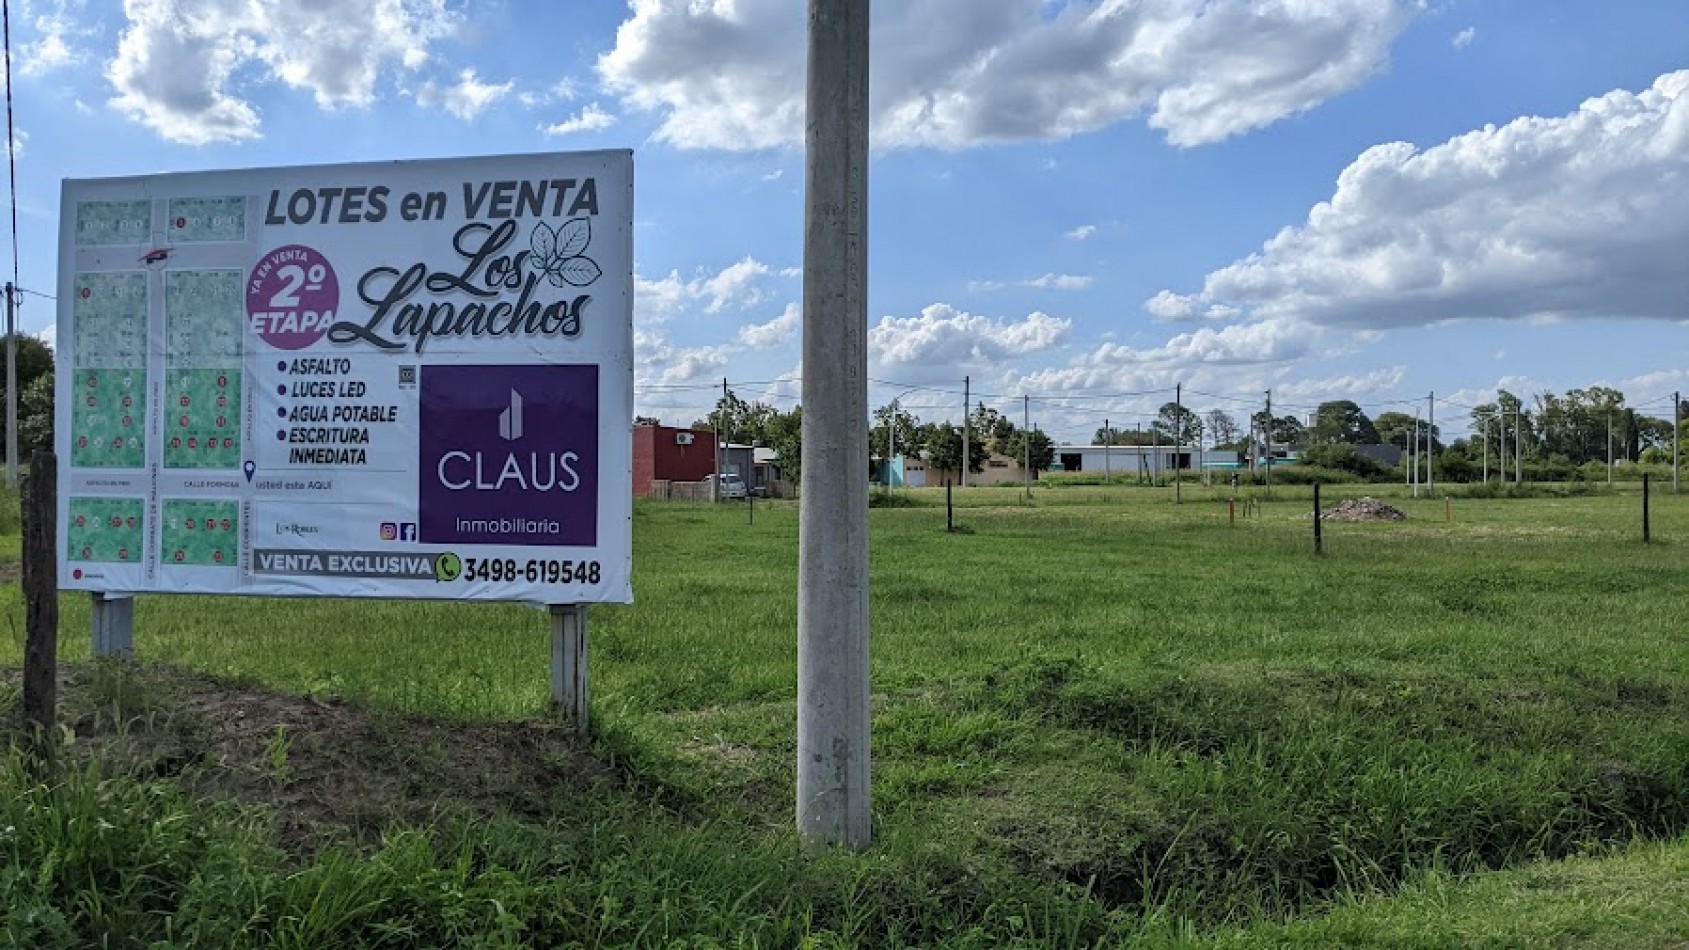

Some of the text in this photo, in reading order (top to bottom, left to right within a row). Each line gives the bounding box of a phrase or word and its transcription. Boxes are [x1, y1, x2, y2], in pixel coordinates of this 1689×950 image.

[265, 186, 390, 225] LOTES
[401, 191, 447, 221] en
[462, 178, 599, 219] VENTA
[271, 250, 308, 265] VENTA
[426, 219, 530, 296] Los
[328, 263, 591, 352] Lapachos
[249, 310, 333, 334] ETAPA
[290, 358, 350, 375] ASFALTO
[291, 382, 365, 398] LUCES LED
[289, 406, 397, 423] AGUA POTABLE
[289, 428, 369, 445] ESCRITURA
[289, 448, 366, 465] INMEDIATA
[438, 451, 580, 491] CLAUS
[256, 481, 283, 490] usted
[456, 516, 560, 535] Inmobiliaria
[259, 553, 432, 575] VENTA EXCLUSIVA
[464, 558, 601, 584] 3498-619548
